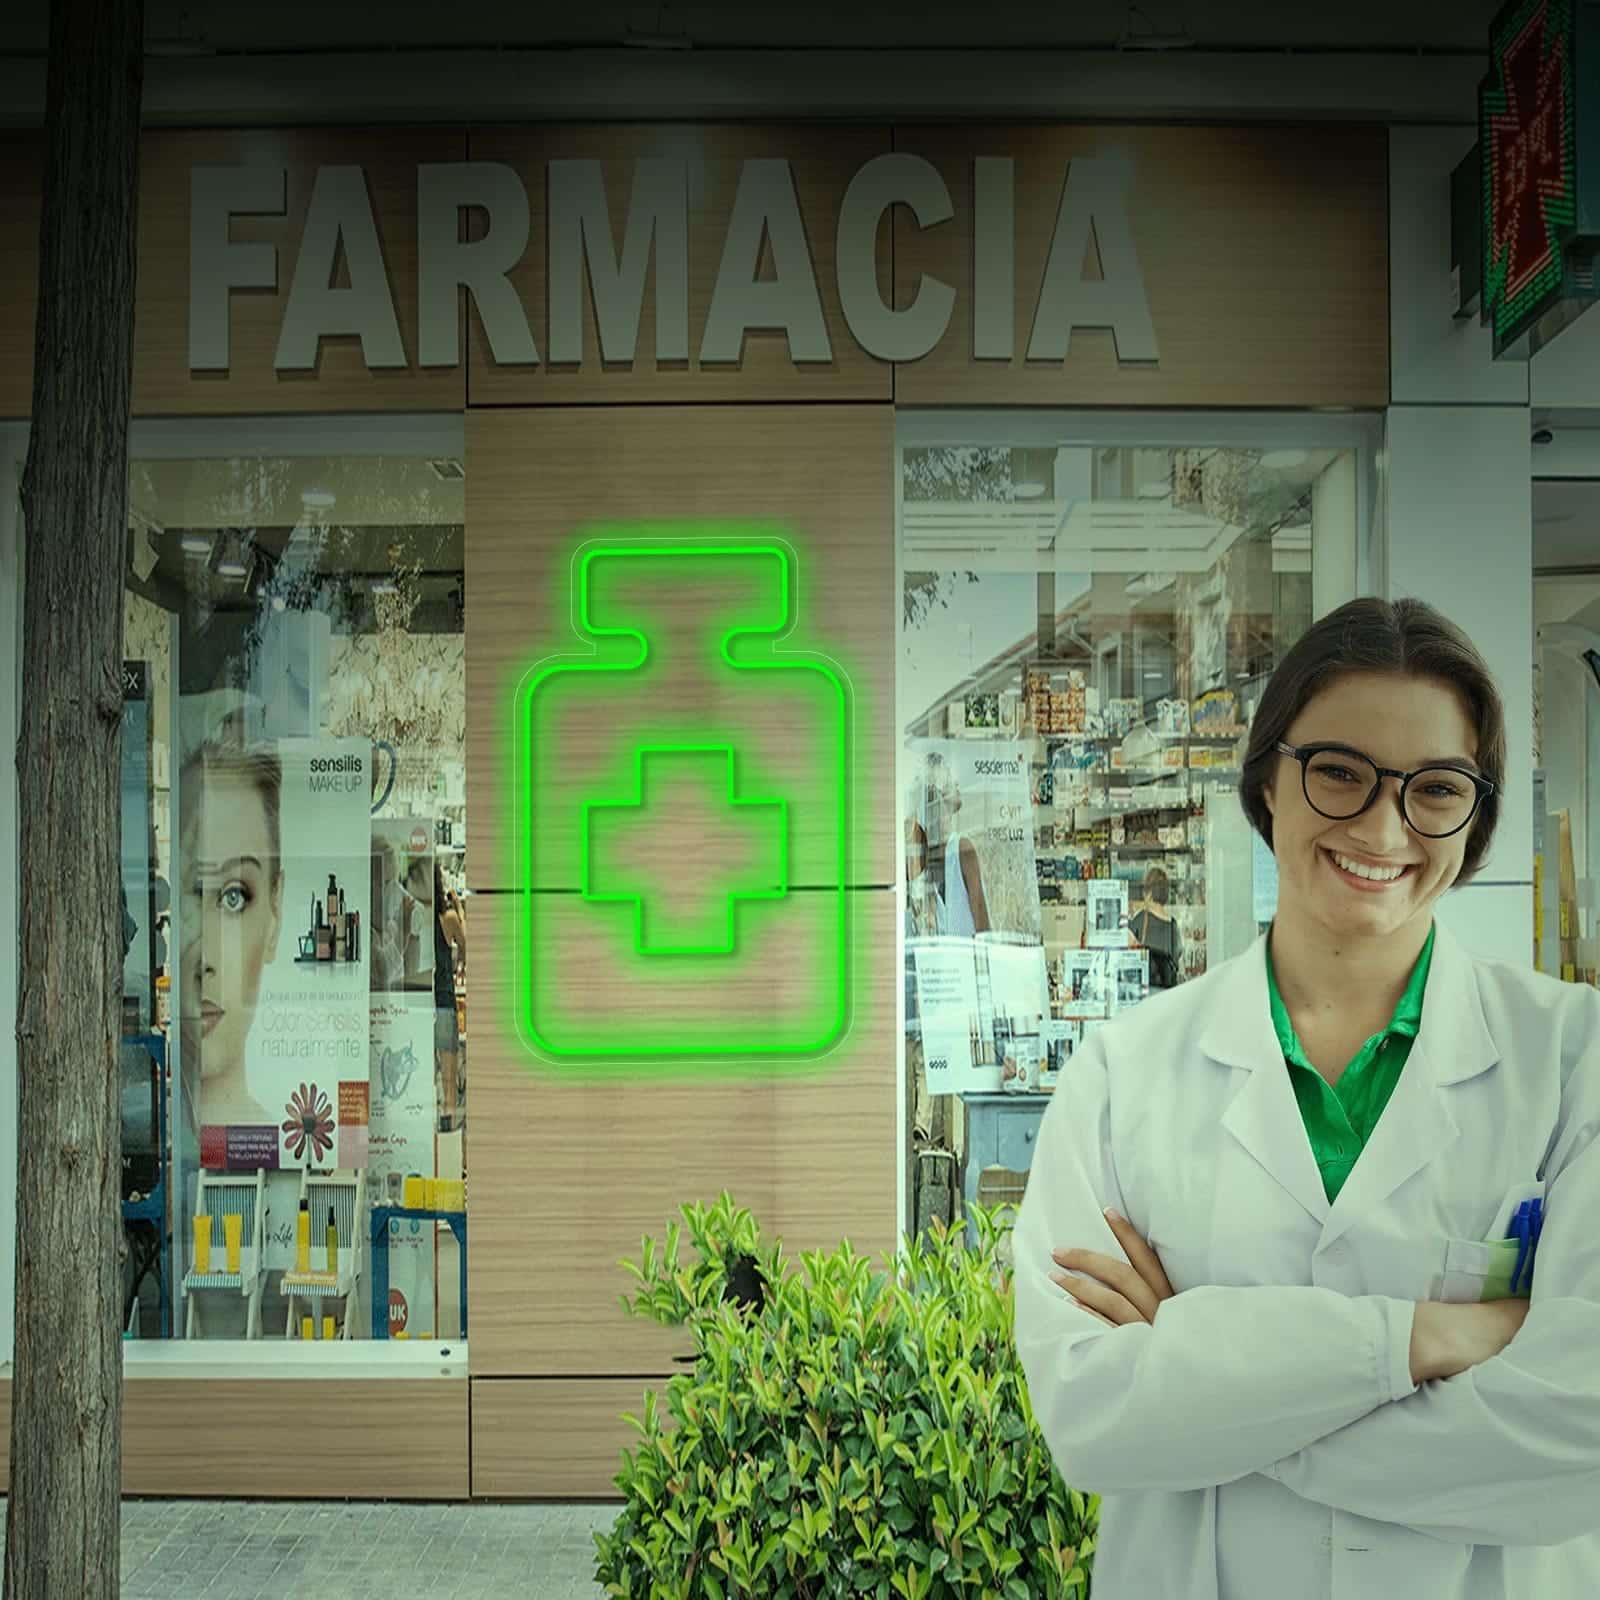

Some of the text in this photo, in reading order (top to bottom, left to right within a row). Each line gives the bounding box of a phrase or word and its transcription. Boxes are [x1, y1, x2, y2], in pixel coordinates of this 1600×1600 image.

[188, 152, 1161, 374] FARMACIA
[309, 753, 363, 773] sensilis
[974, 758, 1021, 775] sesderma
[309, 775, 363, 793] MAKE UP
[1008, 828, 1025, 842] LUZ
[389, 1304, 406, 1321] UK
